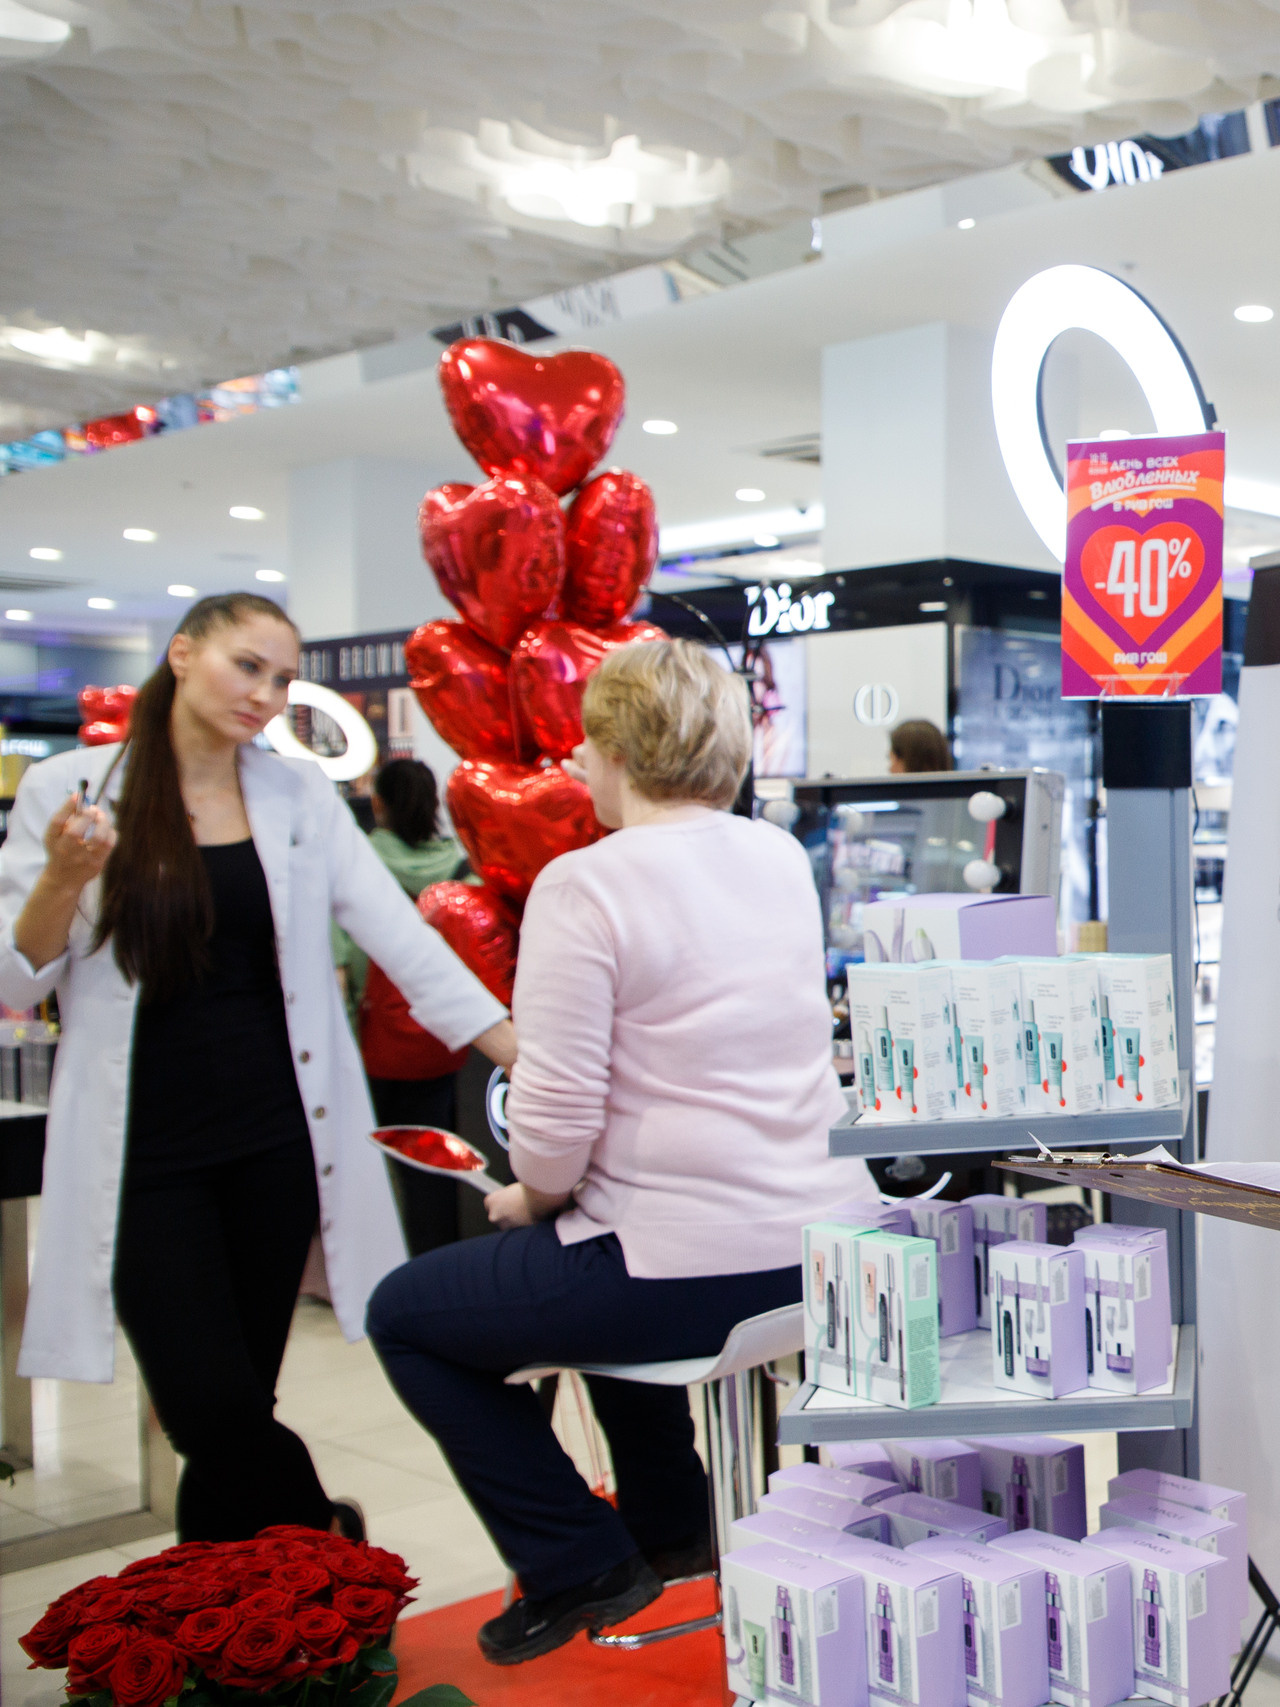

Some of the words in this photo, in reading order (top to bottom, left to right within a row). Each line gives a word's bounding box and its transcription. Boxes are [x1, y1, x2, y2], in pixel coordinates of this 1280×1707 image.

[1110, 458, 1143, 473] ДЕНЬ
[1146, 456, 1179, 469] ВСЕХ
[1095, 537, 1192, 617] -40%
[744, 583, 835, 636] Dior
[1114, 652, 1139, 664] РИВ
[1140, 652, 1167, 663] ГОШ
